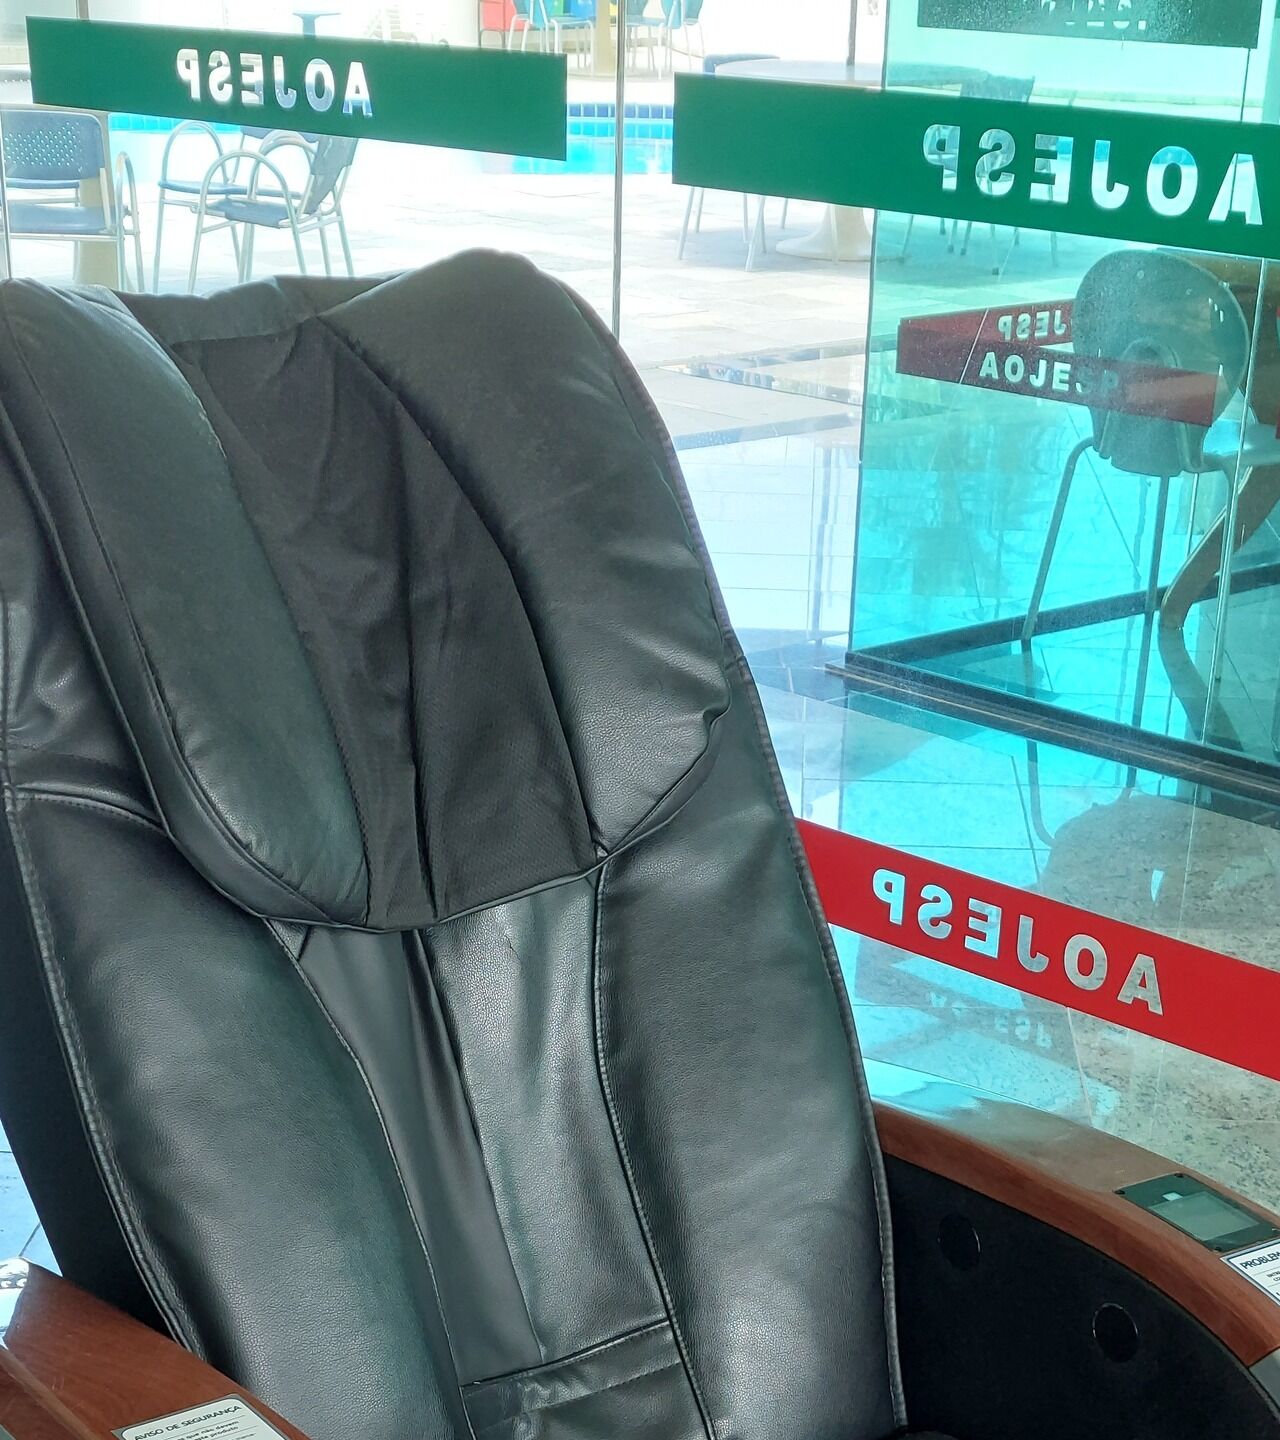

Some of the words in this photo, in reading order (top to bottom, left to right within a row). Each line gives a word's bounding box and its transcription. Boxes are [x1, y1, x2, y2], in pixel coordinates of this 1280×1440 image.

[132, 1428, 165, 1440] AVISO
[164, 1423, 181, 1431] DE
[179, 1404, 242, 1426] SEGURANÇA
